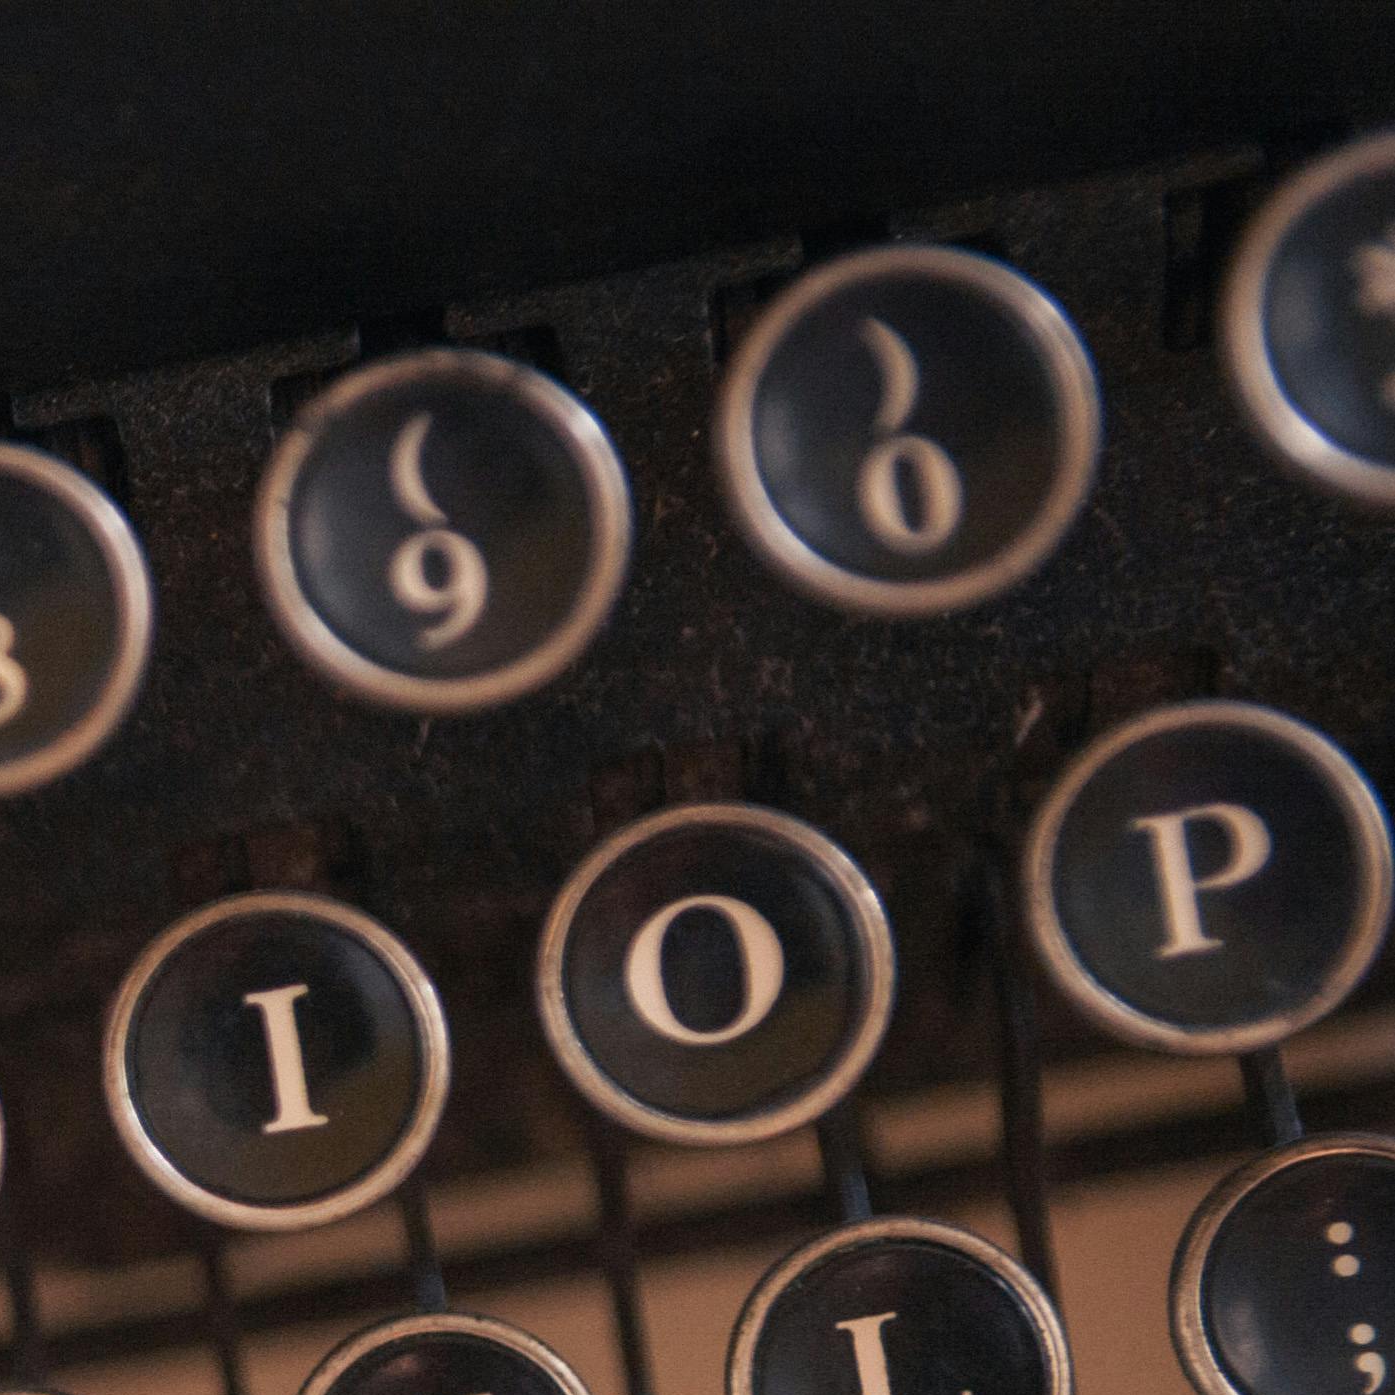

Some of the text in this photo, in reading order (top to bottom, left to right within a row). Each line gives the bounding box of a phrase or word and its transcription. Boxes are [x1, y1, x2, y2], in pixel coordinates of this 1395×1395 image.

[392, 531, 486, 645] 9
[1130, 803, 1270, 958] P
[625, 895, 783, 1045] O
[245, 985, 328, 1134] I
